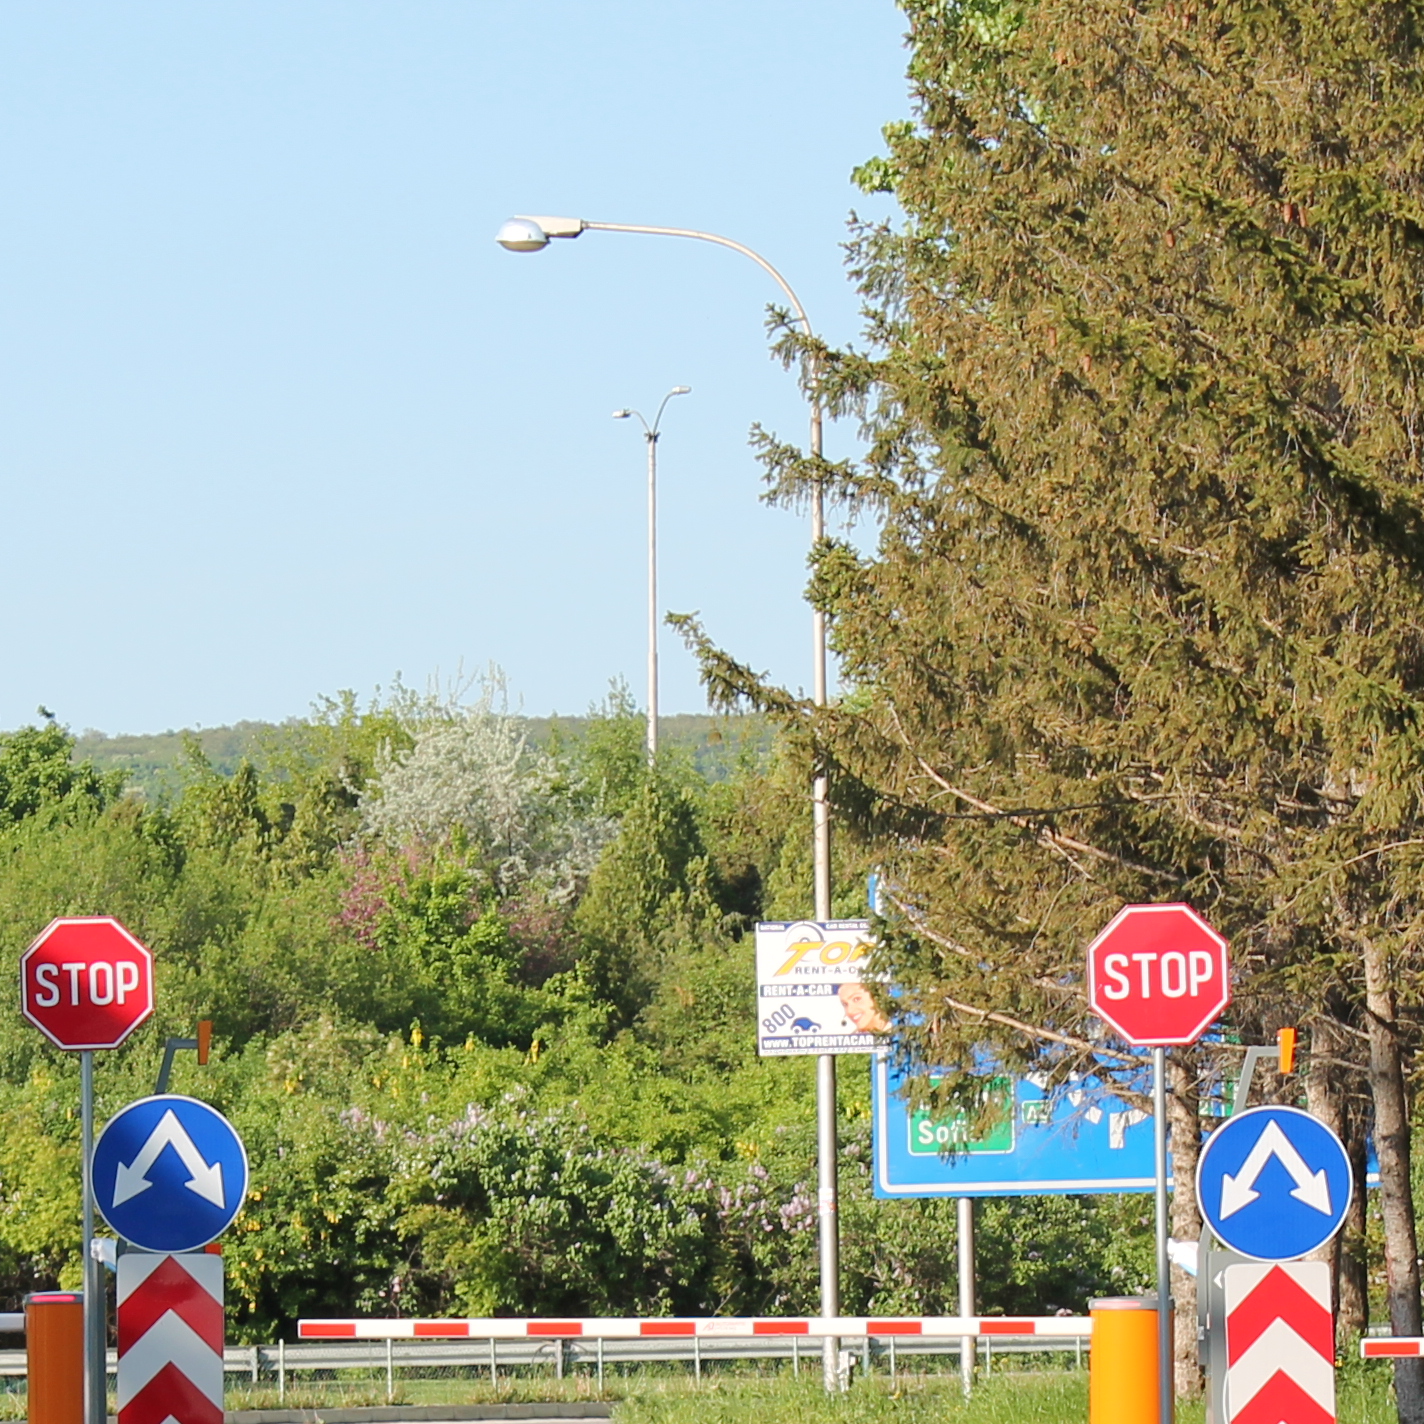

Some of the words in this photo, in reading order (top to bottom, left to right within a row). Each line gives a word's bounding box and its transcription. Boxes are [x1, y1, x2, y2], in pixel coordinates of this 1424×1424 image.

[772, 940, 876, 978] TOP
[795, 966, 865, 975] RENT-A-C
[1104, 951, 1214, 1000] STOP
[35, 961, 139, 1007] STOP
[762, 1003, 796, 1034] 800
[763, 1034, 890, 1049] www.TOPRENTACAR
